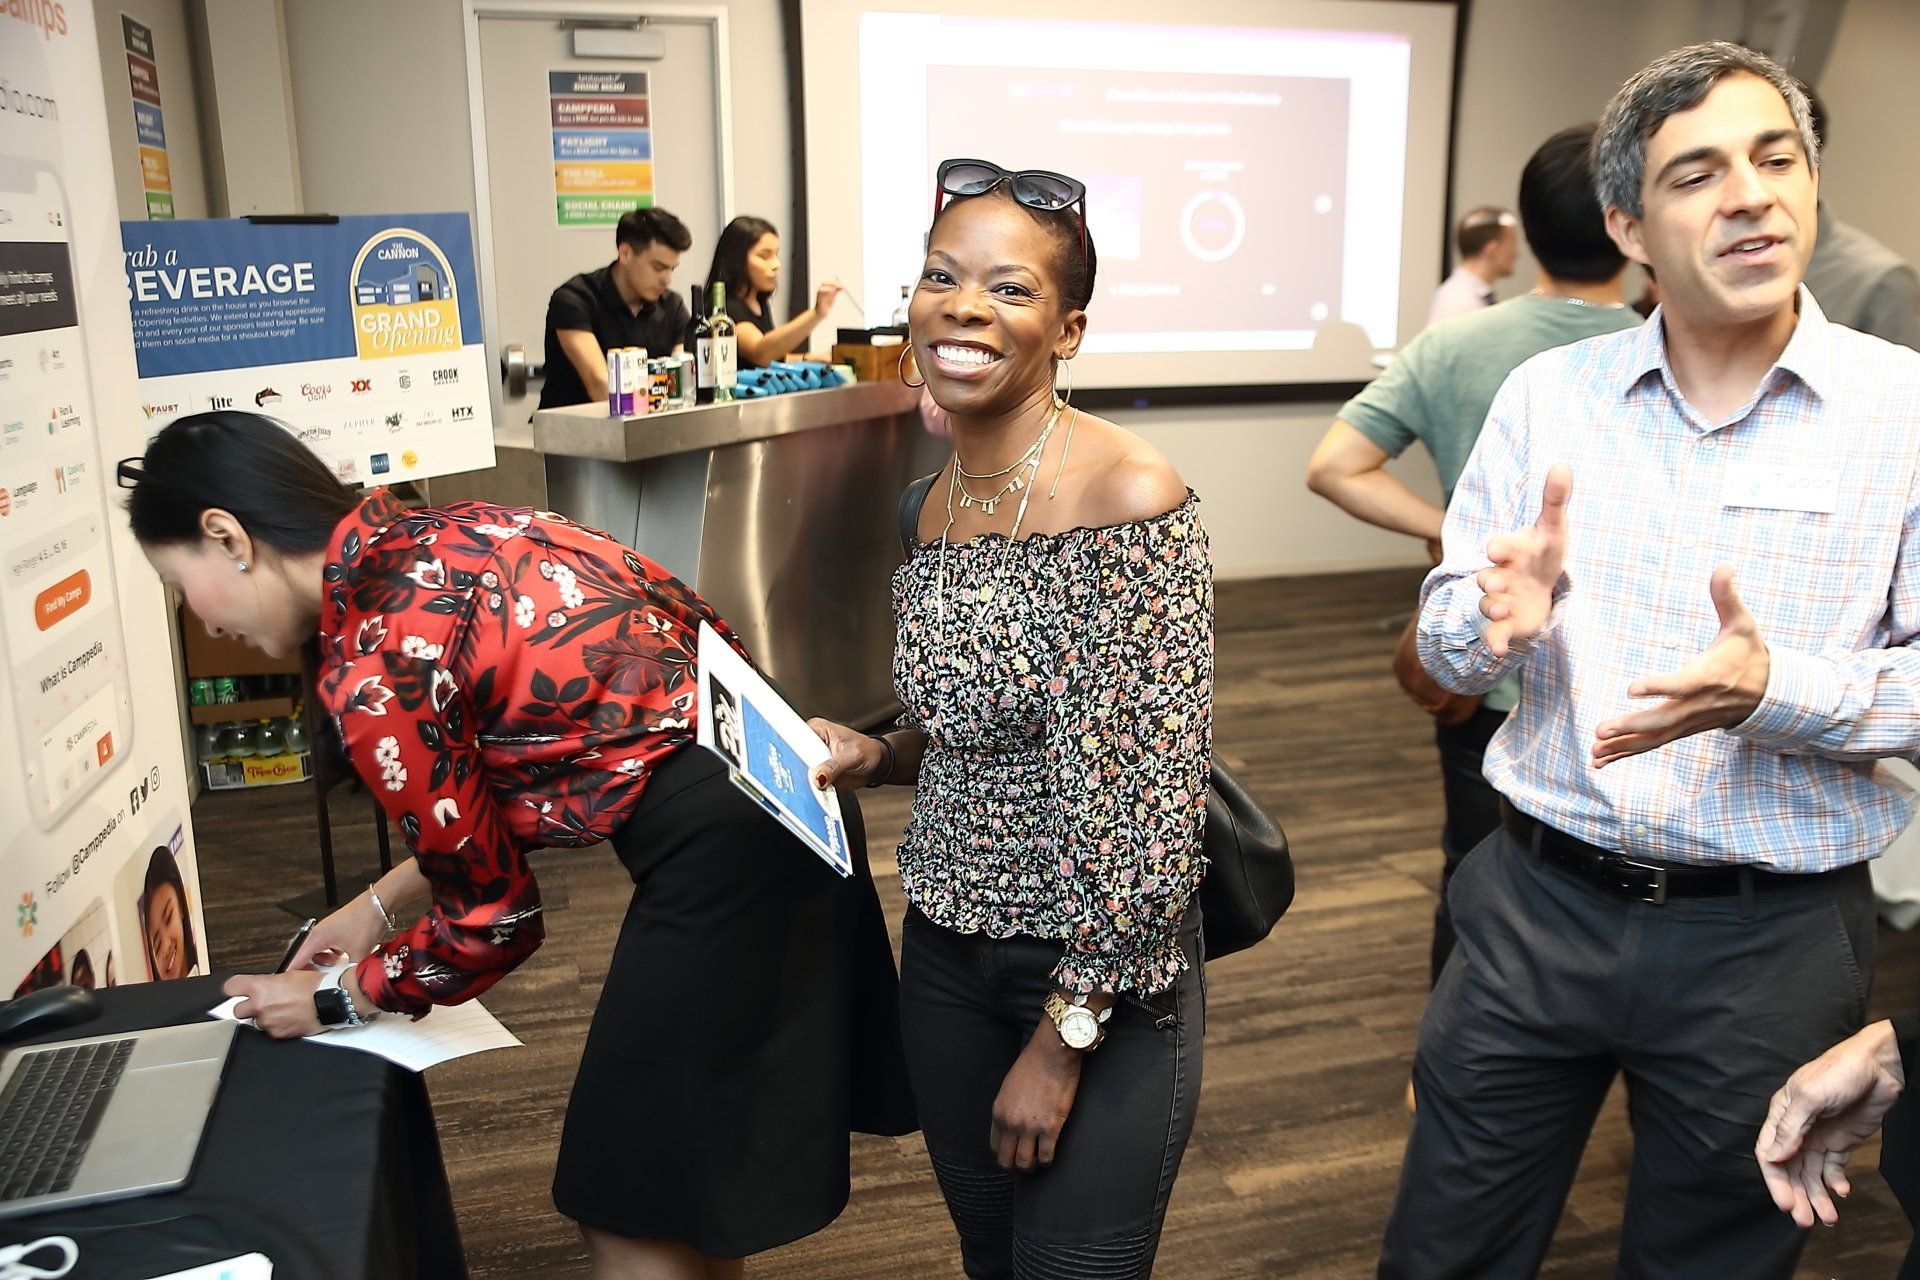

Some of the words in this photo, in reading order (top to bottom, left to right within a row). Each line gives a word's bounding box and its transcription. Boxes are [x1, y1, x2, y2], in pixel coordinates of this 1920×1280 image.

[165, 250, 178, 266] a
[378, 248, 419, 260] CANNON
[141, 306, 180, 316] refreshing
[181, 305, 199, 313] drink
[226, 302, 248, 310] house
[259, 302, 272, 310] you
[139, 318, 172, 328] Opening
[210, 314, 222, 322] We
[224, 312, 248, 320] extend
[263, 310, 284, 318] raving
[286, 306, 326, 316] appreciation
[360, 308, 441, 334] GRAND
[162, 328, 182, 336] every
[222, 322, 254, 331] sponsors
[256, 320, 274, 328] listed
[310, 316, 324, 324] sure
[142, 340, 162, 348] them
[175, 337, 196, 345] social
[198, 334, 220, 343] media
[240, 331, 268, 340] shoutout
[270, 328, 296, 338] tonight!
[373, 323, 456, 352] Opening
[432, 368, 459, 381] CROOK
[300, 383, 332, 396] Coors
[210, 396, 233, 411] Lite
[308, 394, 327, 402] LIGHT
[152, 404, 178, 413] FAUST
[452, 406, 474, 418] HTX
[62, 416, 81, 428] Learning
[44, 601, 58, 614] Find
[58, 597, 66, 608] My
[66, 586, 82, 602] Camps
[40, 668, 60, 694] What
[60, 665, 68, 680] is
[68, 640, 104, 676] Camppedia
[247, 765, 272, 778] Topo
[46, 866, 72, 895] Follow
[72, 818, 118, 875] @Camppedia
[117, 808, 126, 824] on
